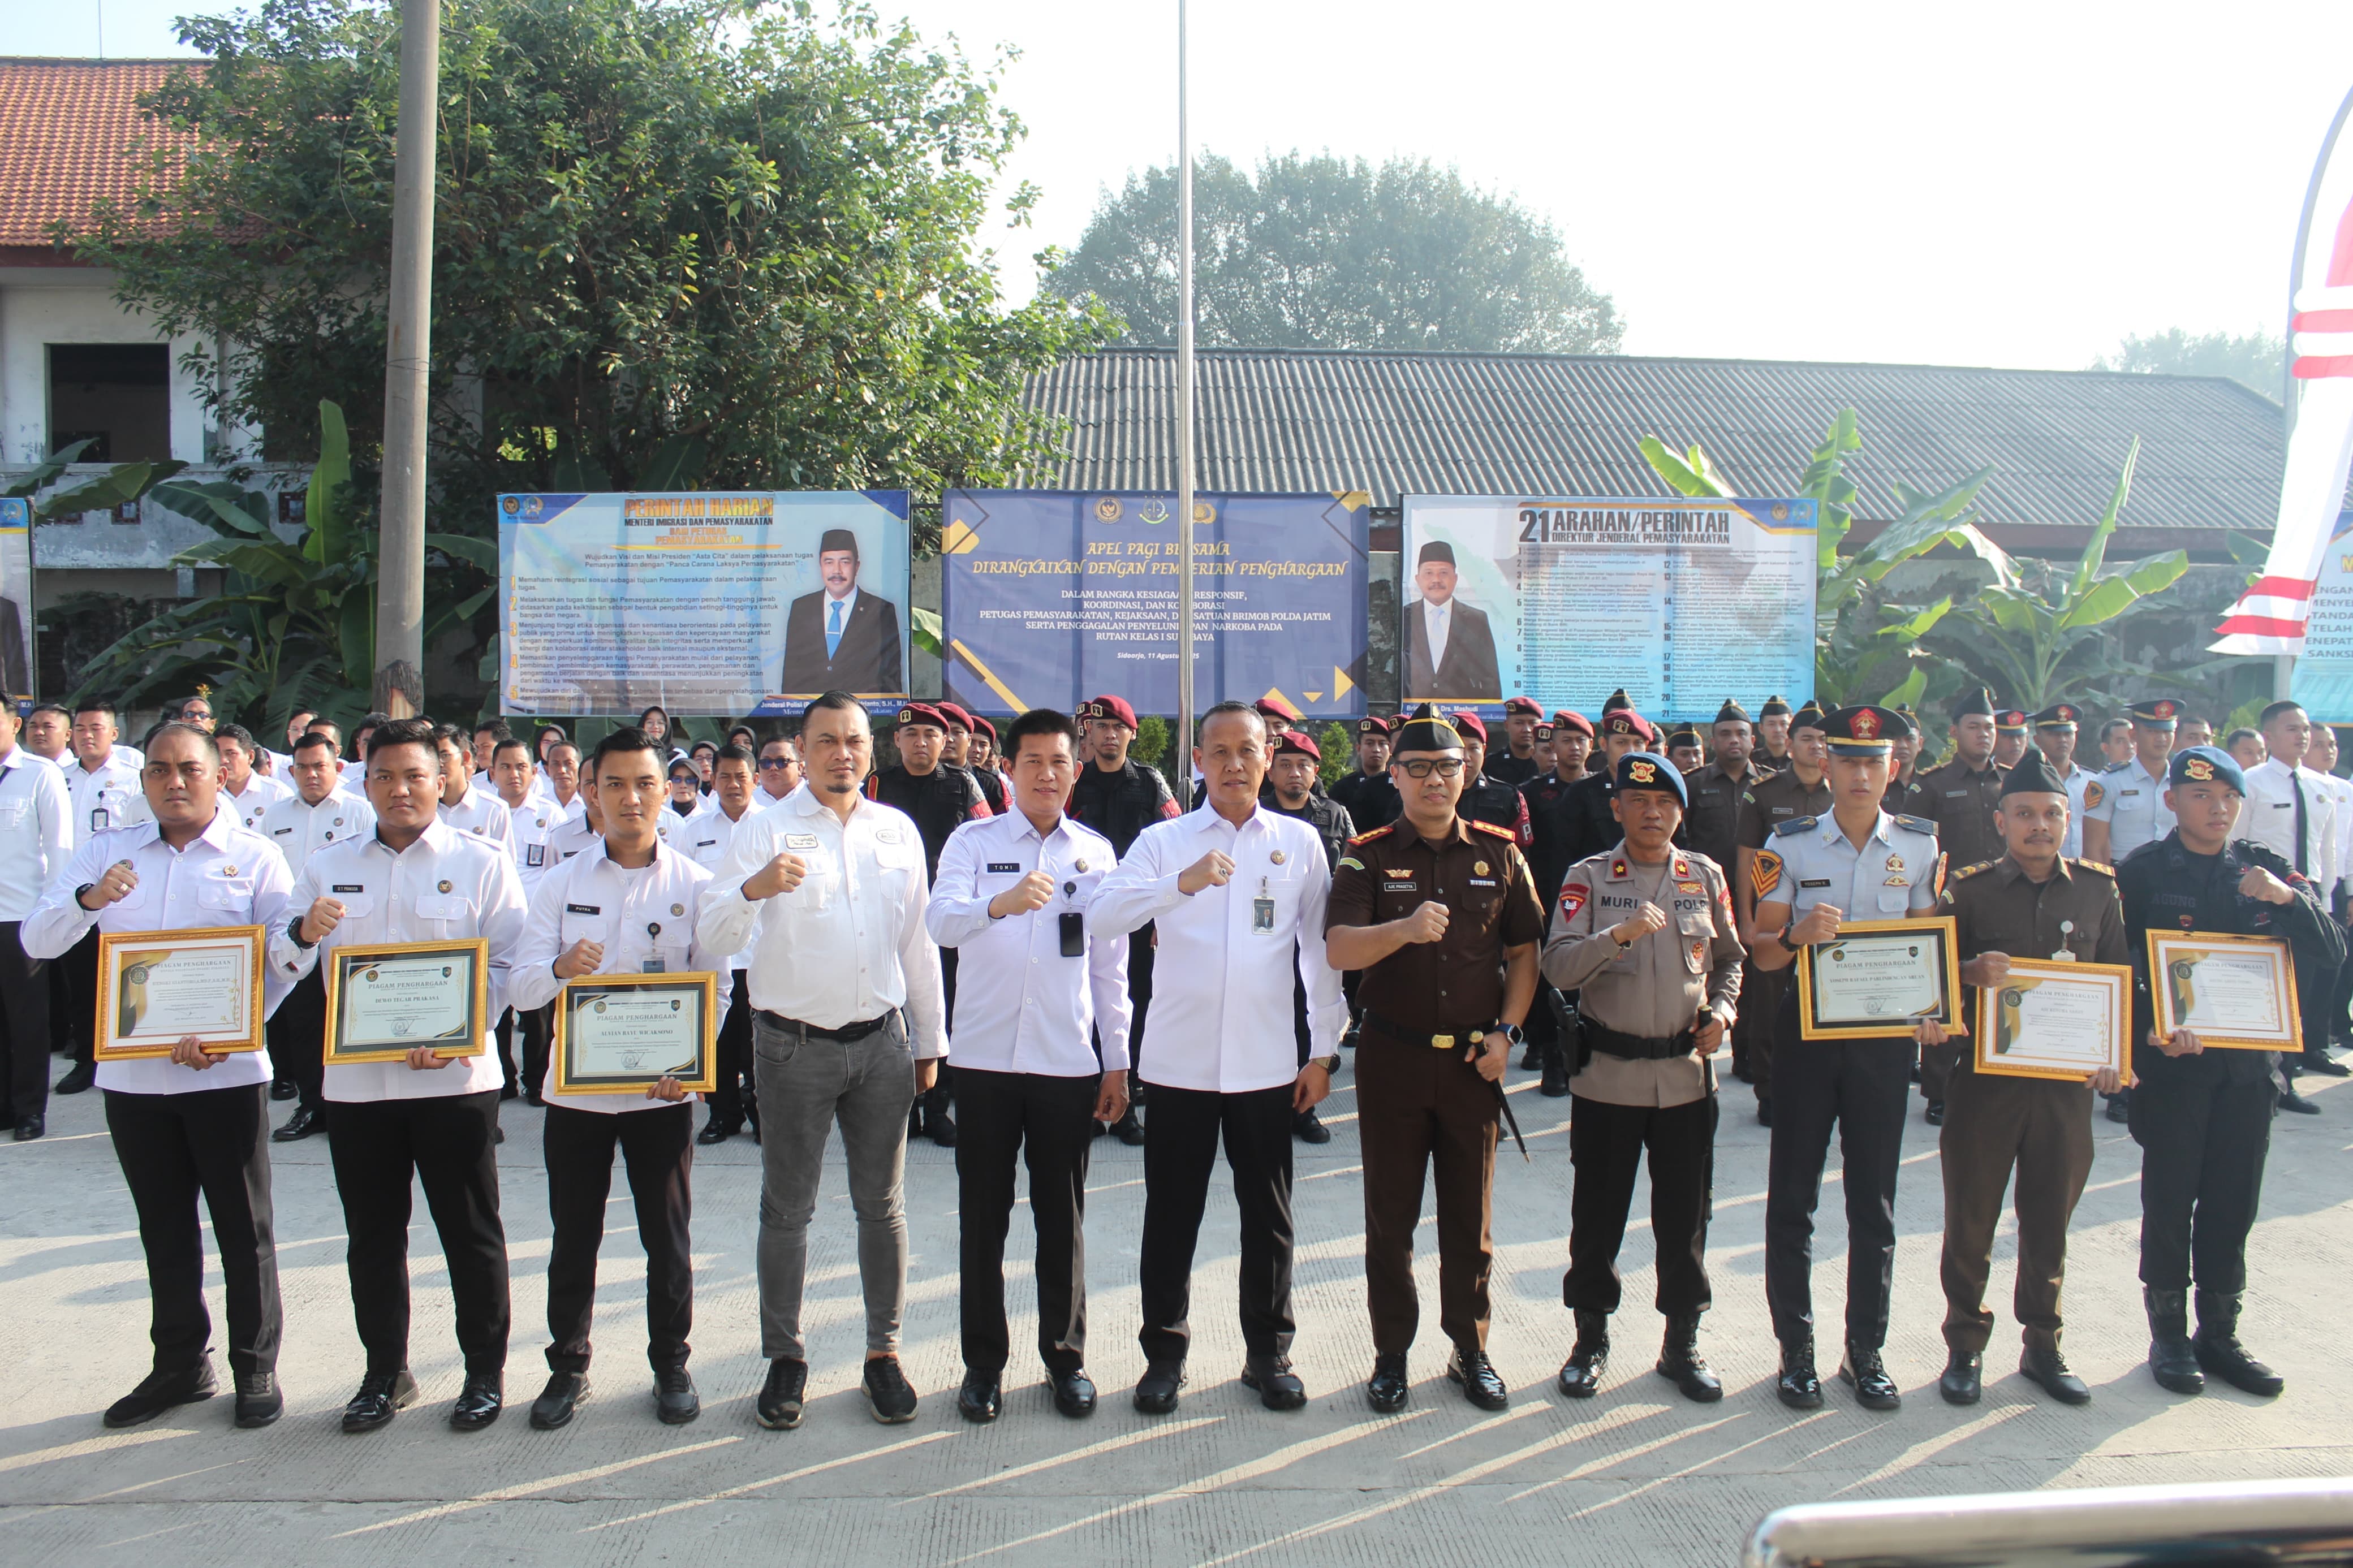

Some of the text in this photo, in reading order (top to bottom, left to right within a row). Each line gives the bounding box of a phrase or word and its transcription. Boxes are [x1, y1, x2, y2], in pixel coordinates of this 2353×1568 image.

[624, 498, 773, 517] PERINTAH HARIAN
[624, 518, 654, 526] MENTERI
[705, 517, 773, 526] PEMASYARAKATAN
[1519, 510, 1549, 542] 21
[1553, 511, 1730, 533] ARAHAN/PERINTAH
[655, 535, 743, 544] PEMASYARAKATAN
[1552, 532, 1730, 544] DIREKTUR JENDERAL PEMASYARAKATAN
[1087, 541, 1231, 559] APEL PAGI BESAMA
[973, 559, 1349, 579] DIRANGKAIKAN DENGAN PEMERIAN PENGHARGAAN
[510, 576, 516, 590] 1
[1096, 590, 1135, 599] RANGKA
[1194, 591, 1247, 601] RESPONSIF,
[510, 597, 518, 611] 2
[1084, 601, 1144, 611] KOORDINASI,
[1023, 611, 1113, 620] PEMASYARAKATAN,
[1115, 612, 1170, 621] KEJAKSAAN,
[510, 622, 517, 637] 3
[2312, 624, 2352, 633] TELAH
[510, 654, 518, 669] 4
[510, 685, 518, 699] 5
[1523, 823, 1531, 841] P
[2153, 893, 2196, 908] AGUNG
